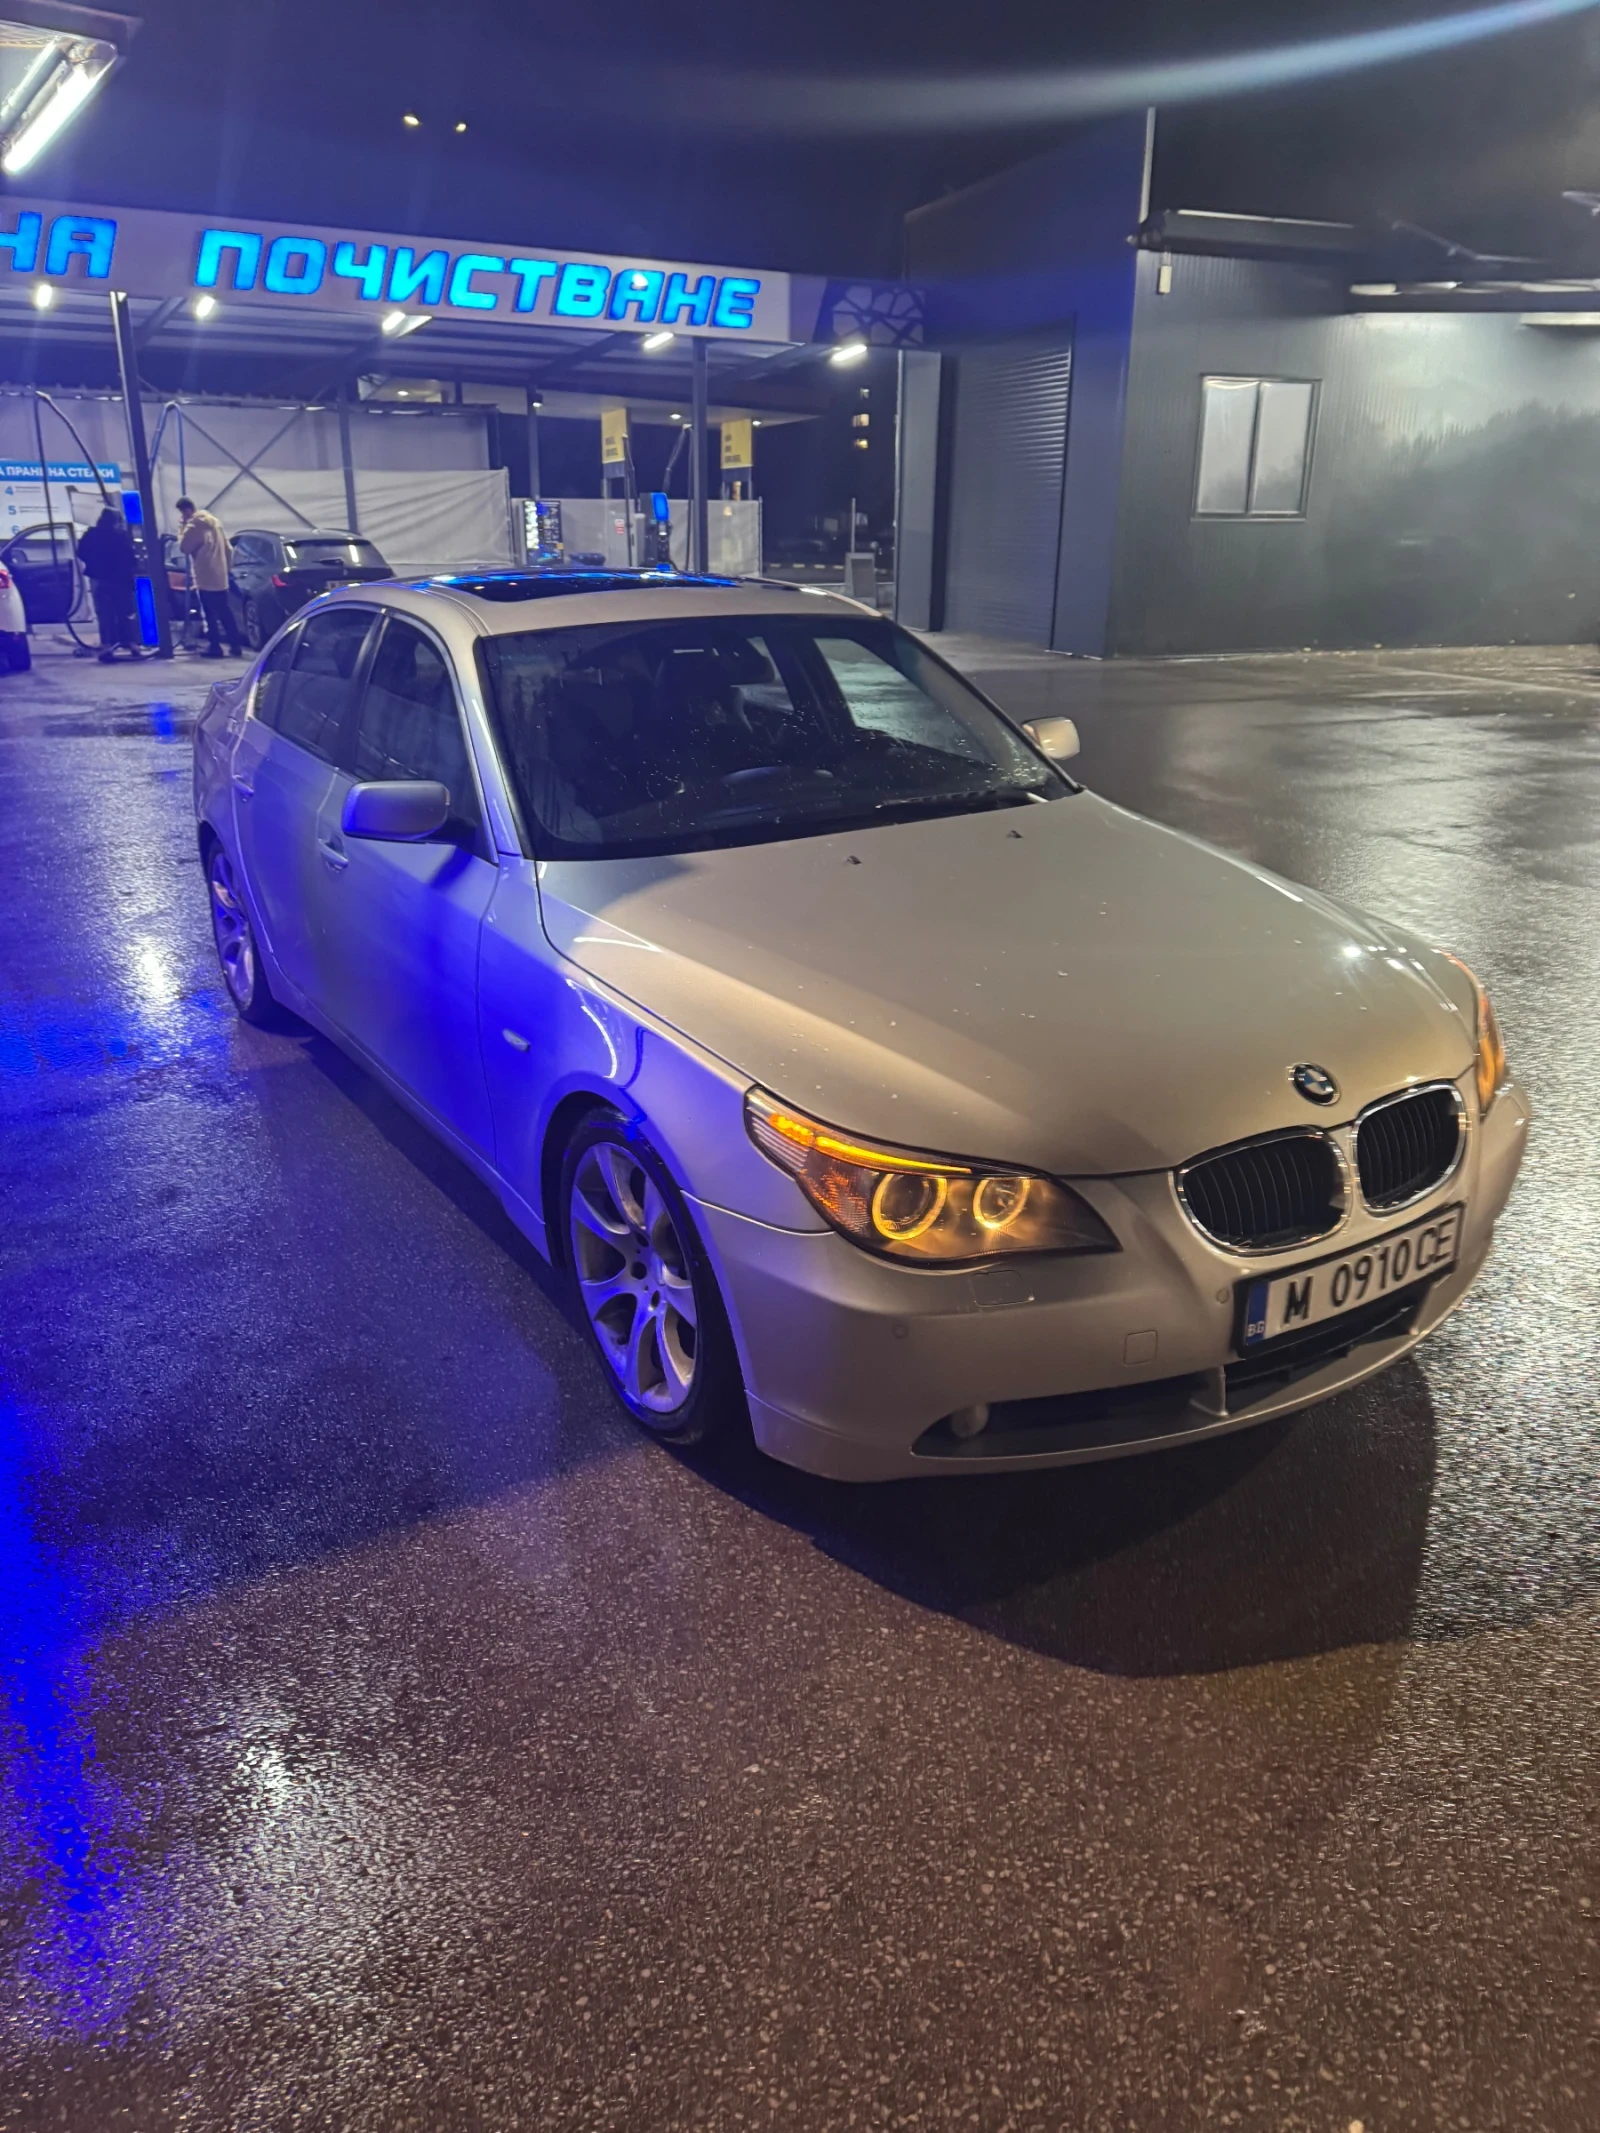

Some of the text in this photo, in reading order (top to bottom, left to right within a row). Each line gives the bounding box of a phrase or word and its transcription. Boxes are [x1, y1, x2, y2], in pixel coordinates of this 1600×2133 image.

[194, 229, 761, 329] ПОЧИСТВАНЕ
[48, 467, 66, 477] НА
[5, 486, 14, 496] 4
[8, 505, 17, 515] 5
[1284, 1275, 1314, 1325] M
[1247, 1321, 1265, 1338] BG
